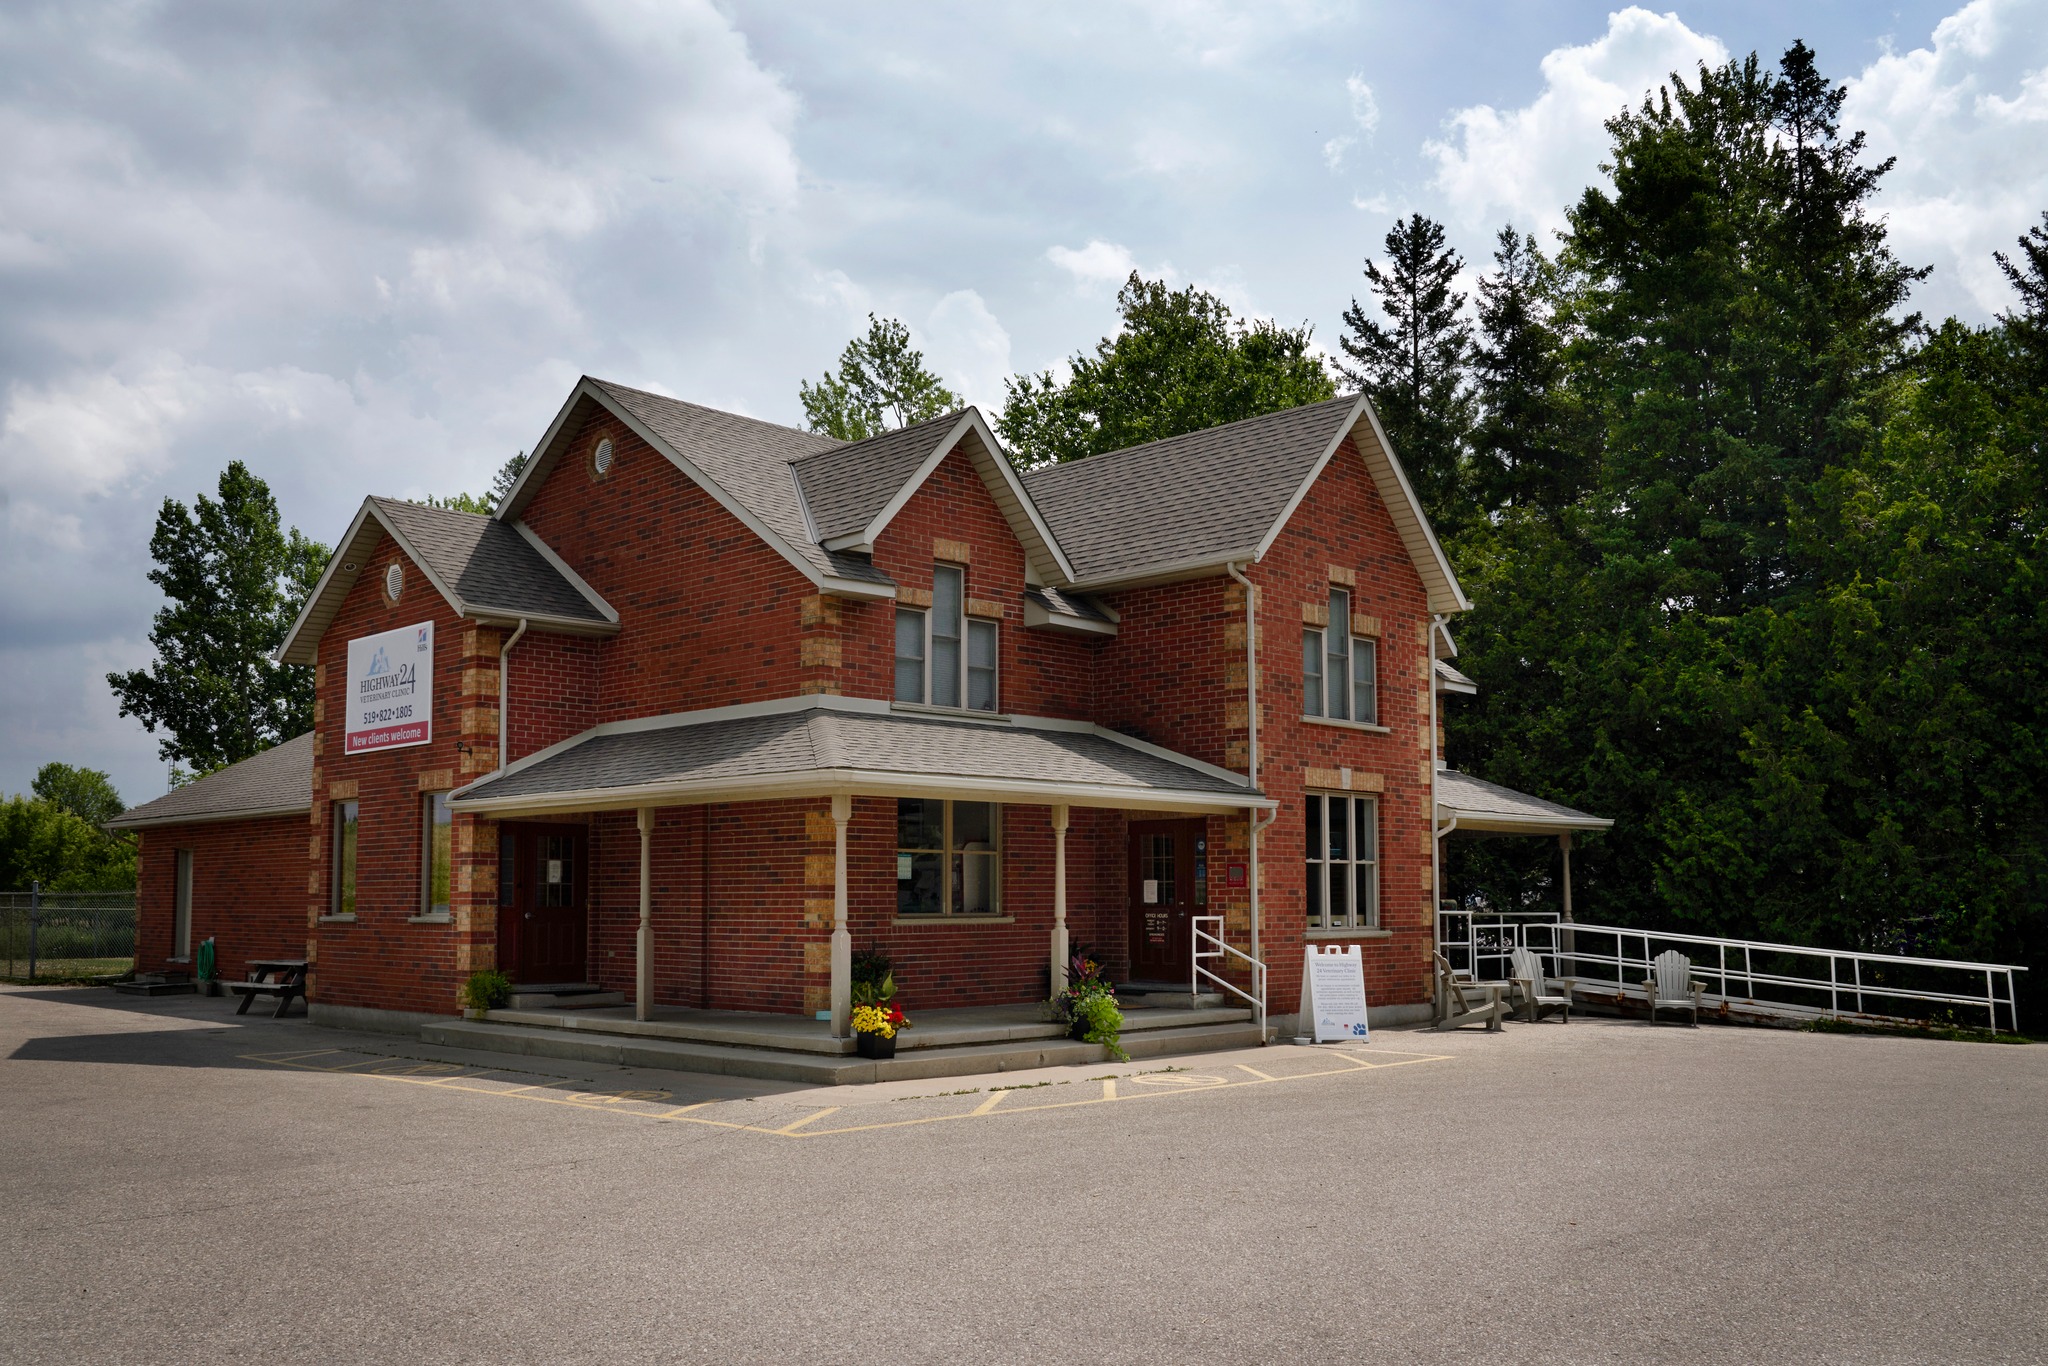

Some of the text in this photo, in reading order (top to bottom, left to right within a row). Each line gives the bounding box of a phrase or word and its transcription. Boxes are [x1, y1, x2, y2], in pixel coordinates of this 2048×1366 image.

[360, 663, 416, 694] HIGHWAY 24
[360, 687, 410, 703] VETERINARY CLINIC
[352, 728, 421, 747] New clients welcome
